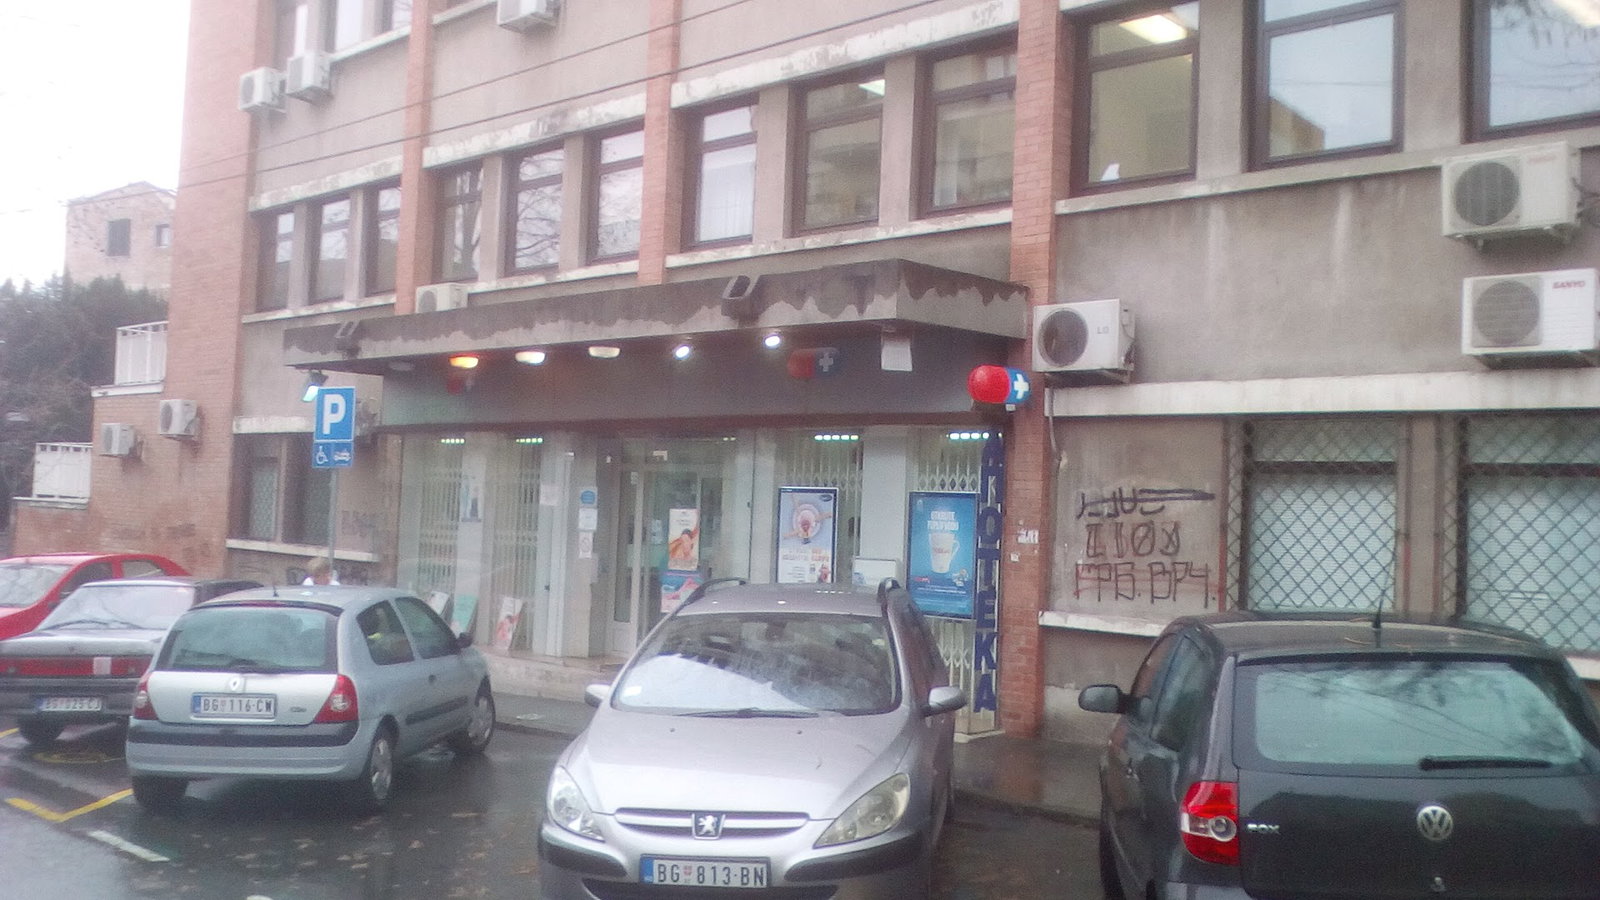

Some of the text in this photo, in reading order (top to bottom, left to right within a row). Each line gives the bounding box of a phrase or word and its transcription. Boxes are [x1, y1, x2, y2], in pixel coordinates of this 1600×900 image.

[1552, 280, 1586, 290] SANYO
[322, 393, 347, 435] P
[203, 698, 219, 712] BG
[657, 863, 680, 883] BG
